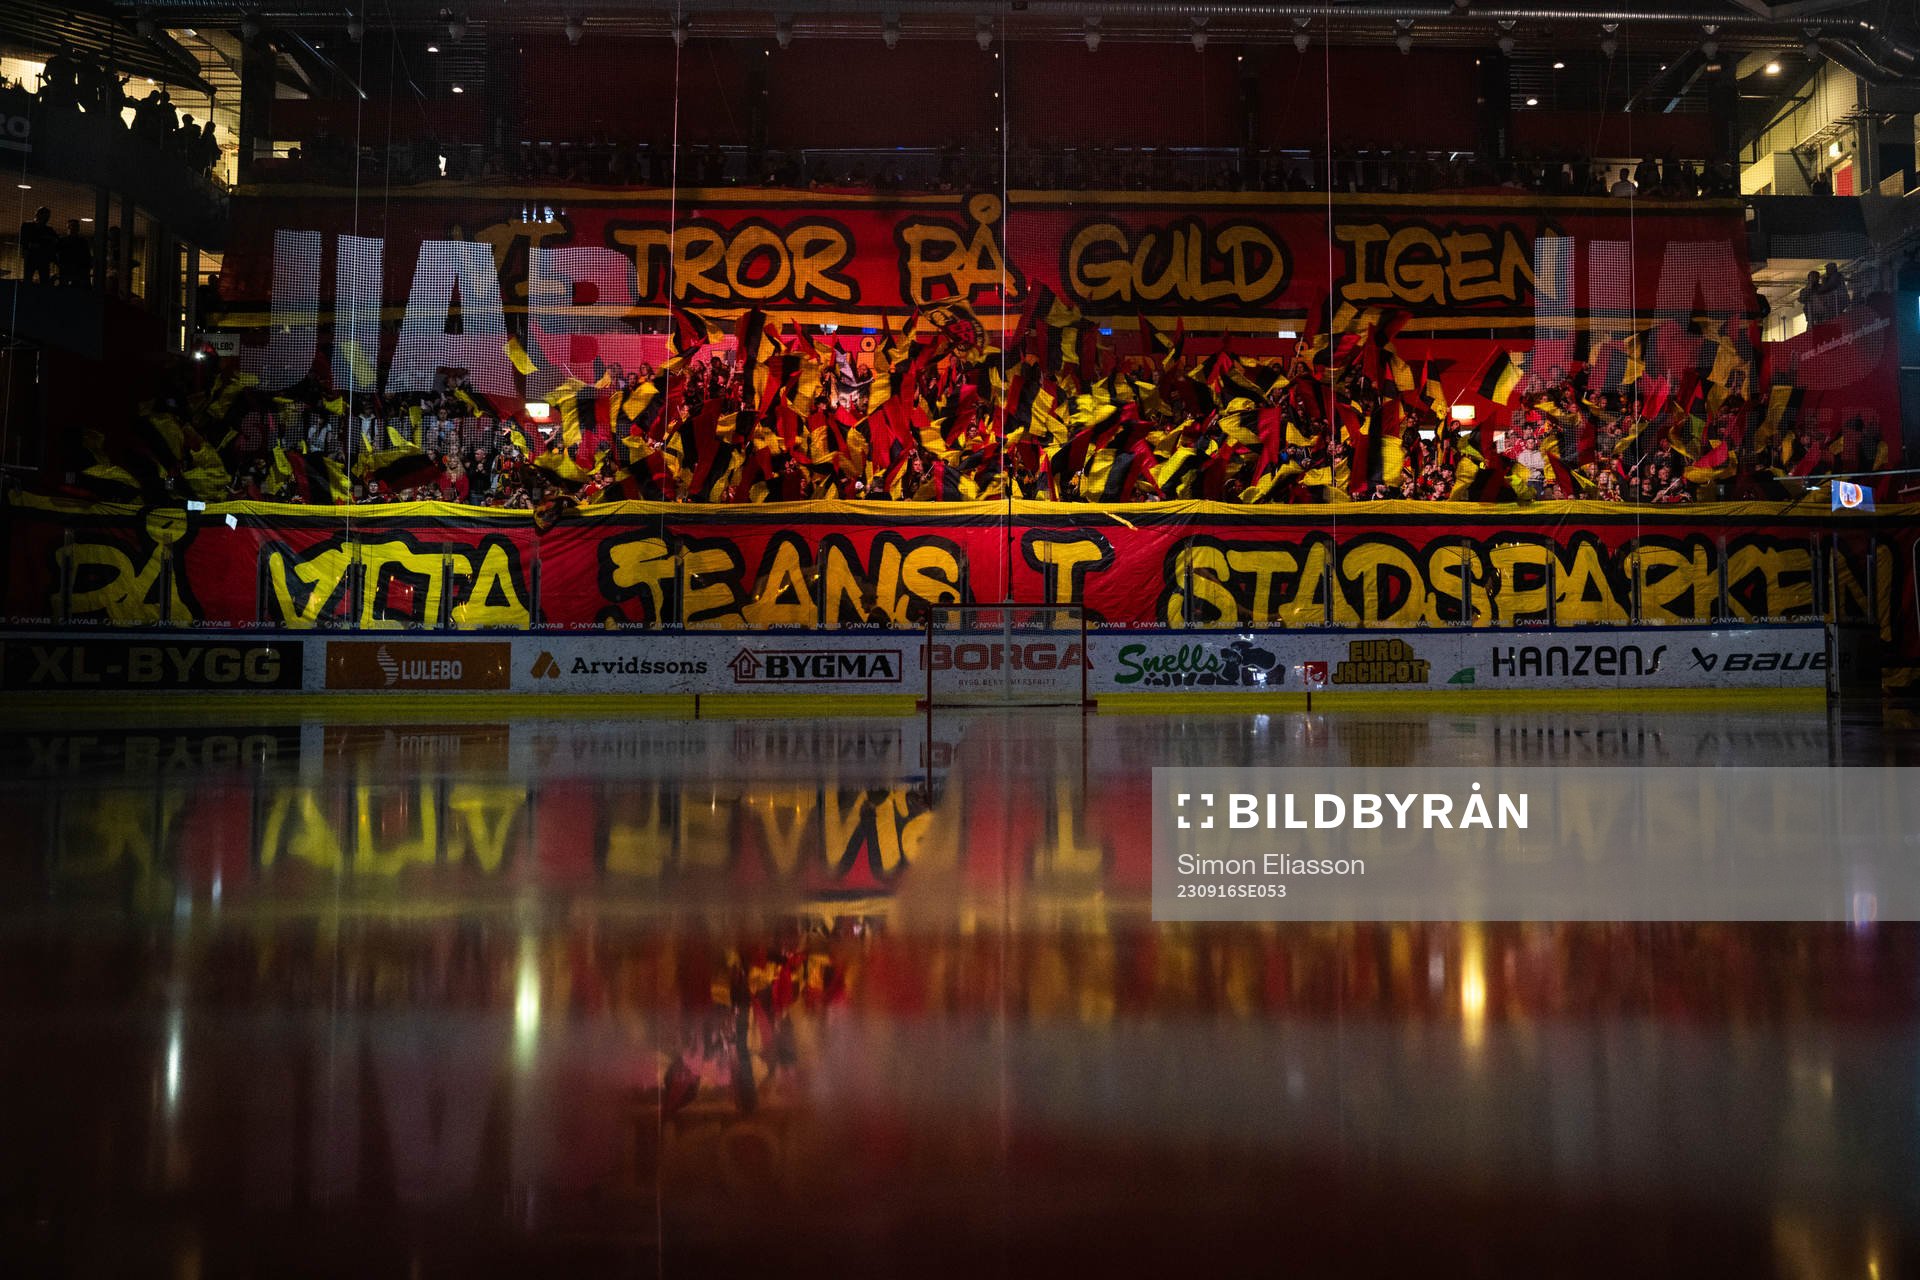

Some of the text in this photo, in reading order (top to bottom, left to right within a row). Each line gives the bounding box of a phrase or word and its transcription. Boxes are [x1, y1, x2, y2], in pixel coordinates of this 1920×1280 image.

[610, 225, 855, 301] TROR
[902, 192, 1019, 305] PÅ
[1068, 221, 1287, 303] GULD
[1334, 216, 1559, 305] IGEN
[51, 508, 194, 629] PÅ
[1167, 538, 1895, 643] STADSPARKEN
[617, 622, 644, 630] NYAB
[1100, 621, 1127, 629] NYAB
[1140, 621, 1168, 629] NYAB
[920, 643, 1095, 671] BORGA
[1349, 639, 1404, 661] EURO
[27, 645, 282, 684] XL-BYGG
[400, 658, 463, 680] LULEBO
[570, 657, 708, 677] Arvidssons
[765, 655, 896, 679] BYGMA
[1114, 643, 1225, 685] Snells
[1331, 659, 1430, 684] JACKPOT
